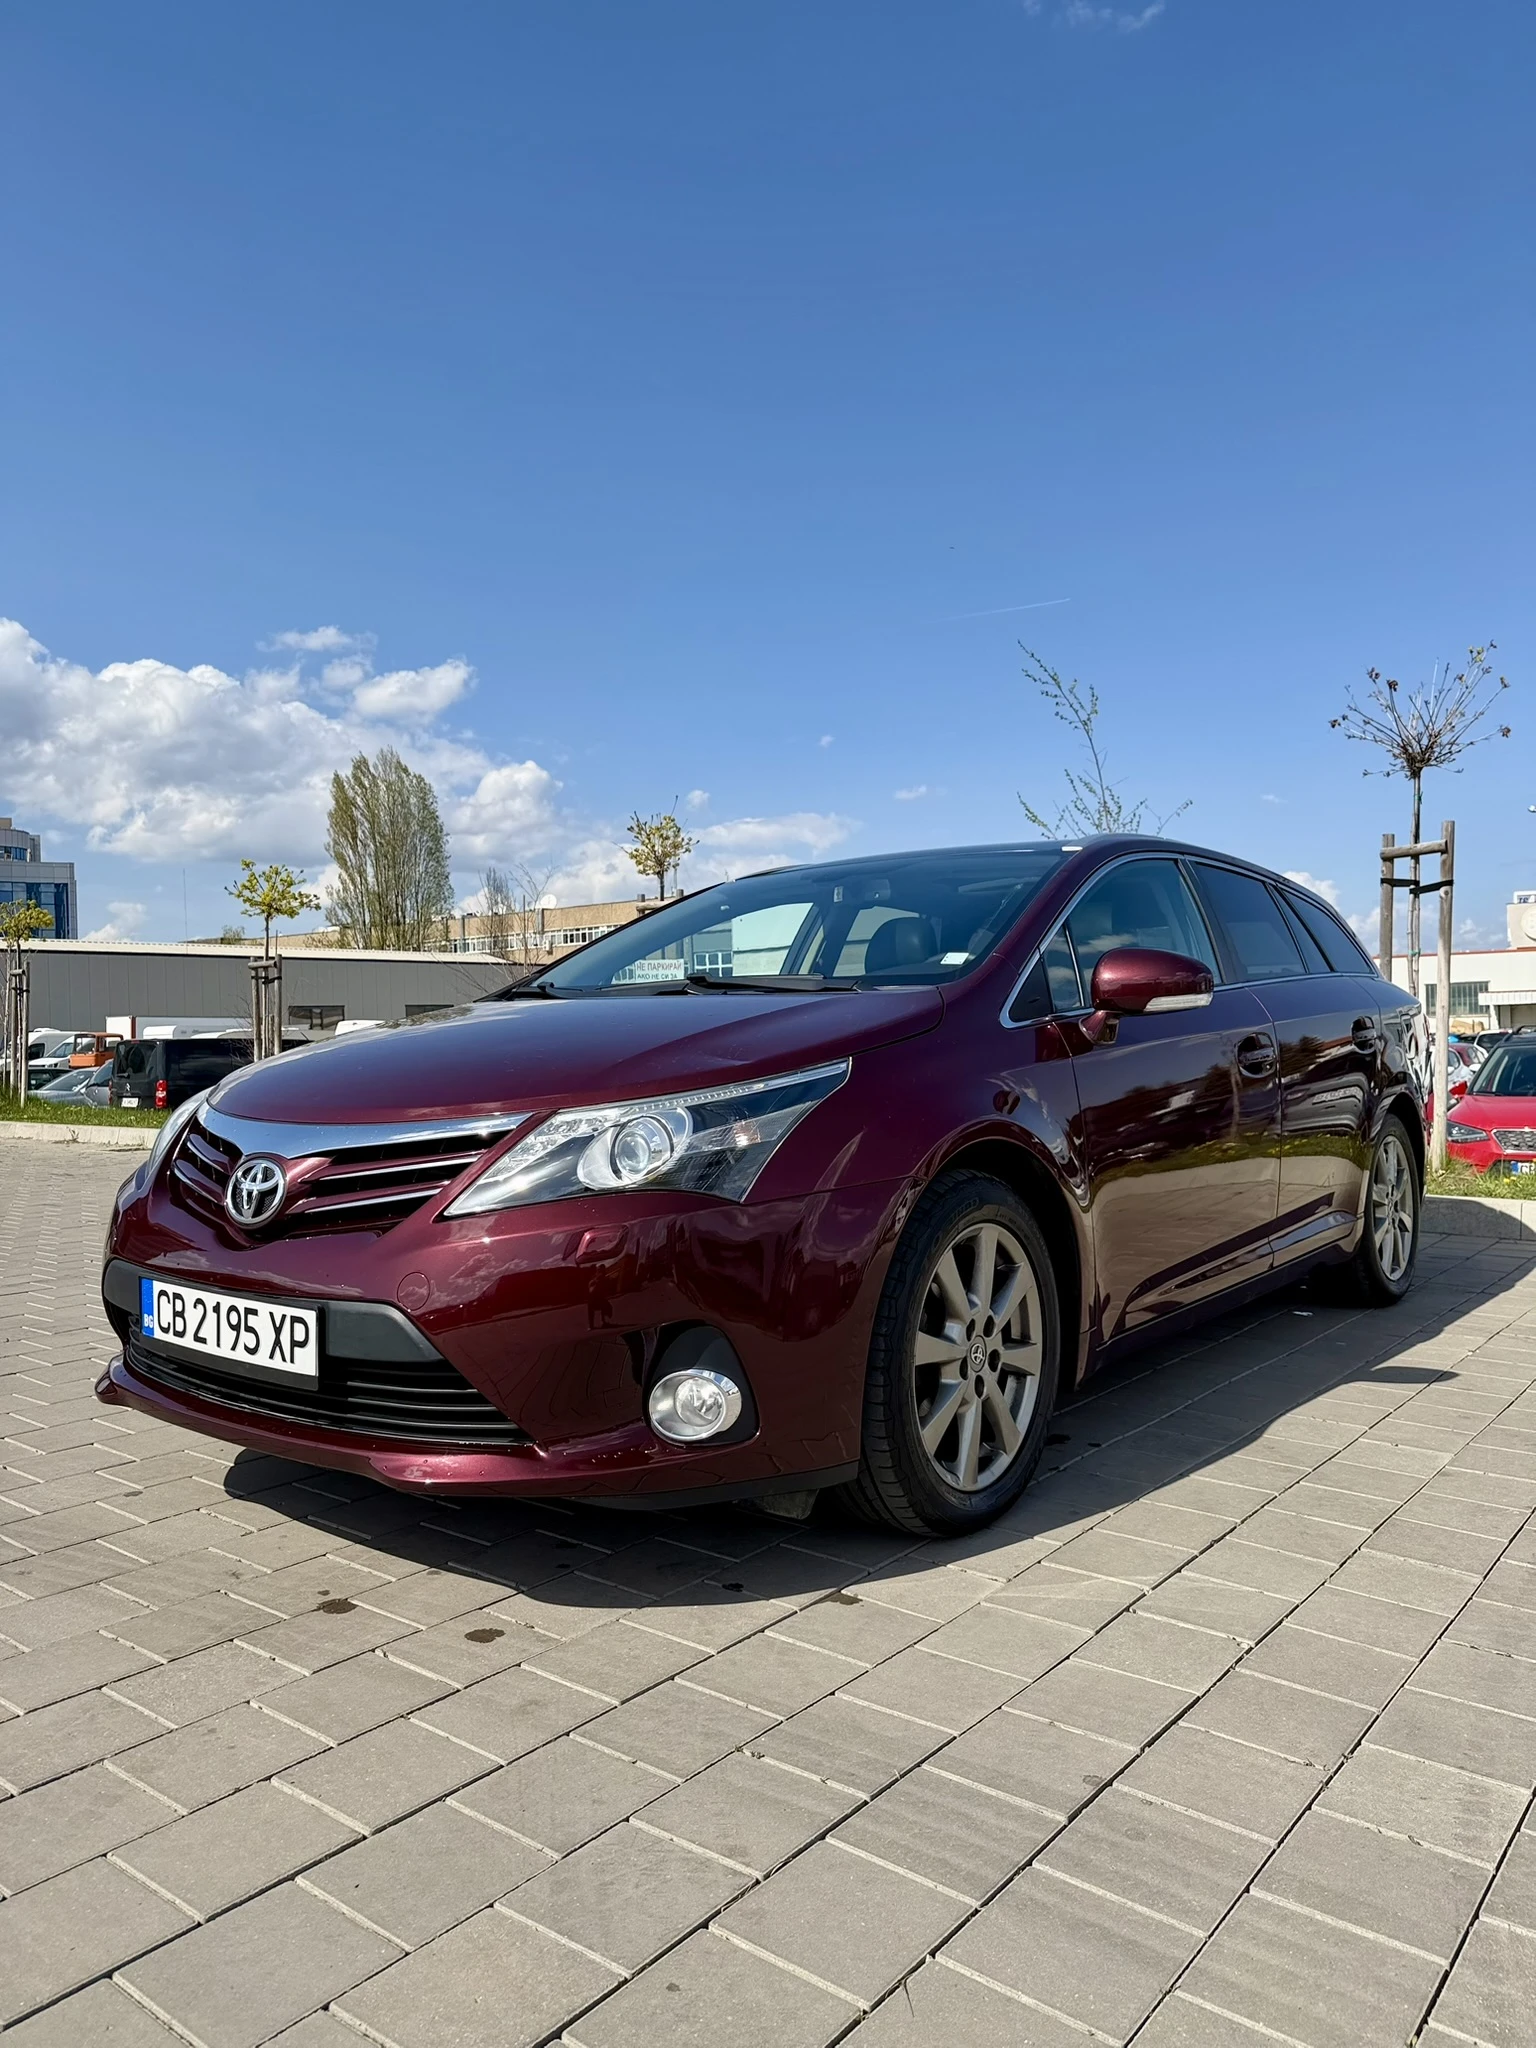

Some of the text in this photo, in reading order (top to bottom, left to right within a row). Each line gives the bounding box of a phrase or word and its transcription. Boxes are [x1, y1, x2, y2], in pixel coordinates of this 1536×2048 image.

[637, 961, 682, 971] НЕ ПАРКИРАЙ
[144, 1313, 154, 1329] BG
[157, 1289, 310, 1364] CB 2195 XP
